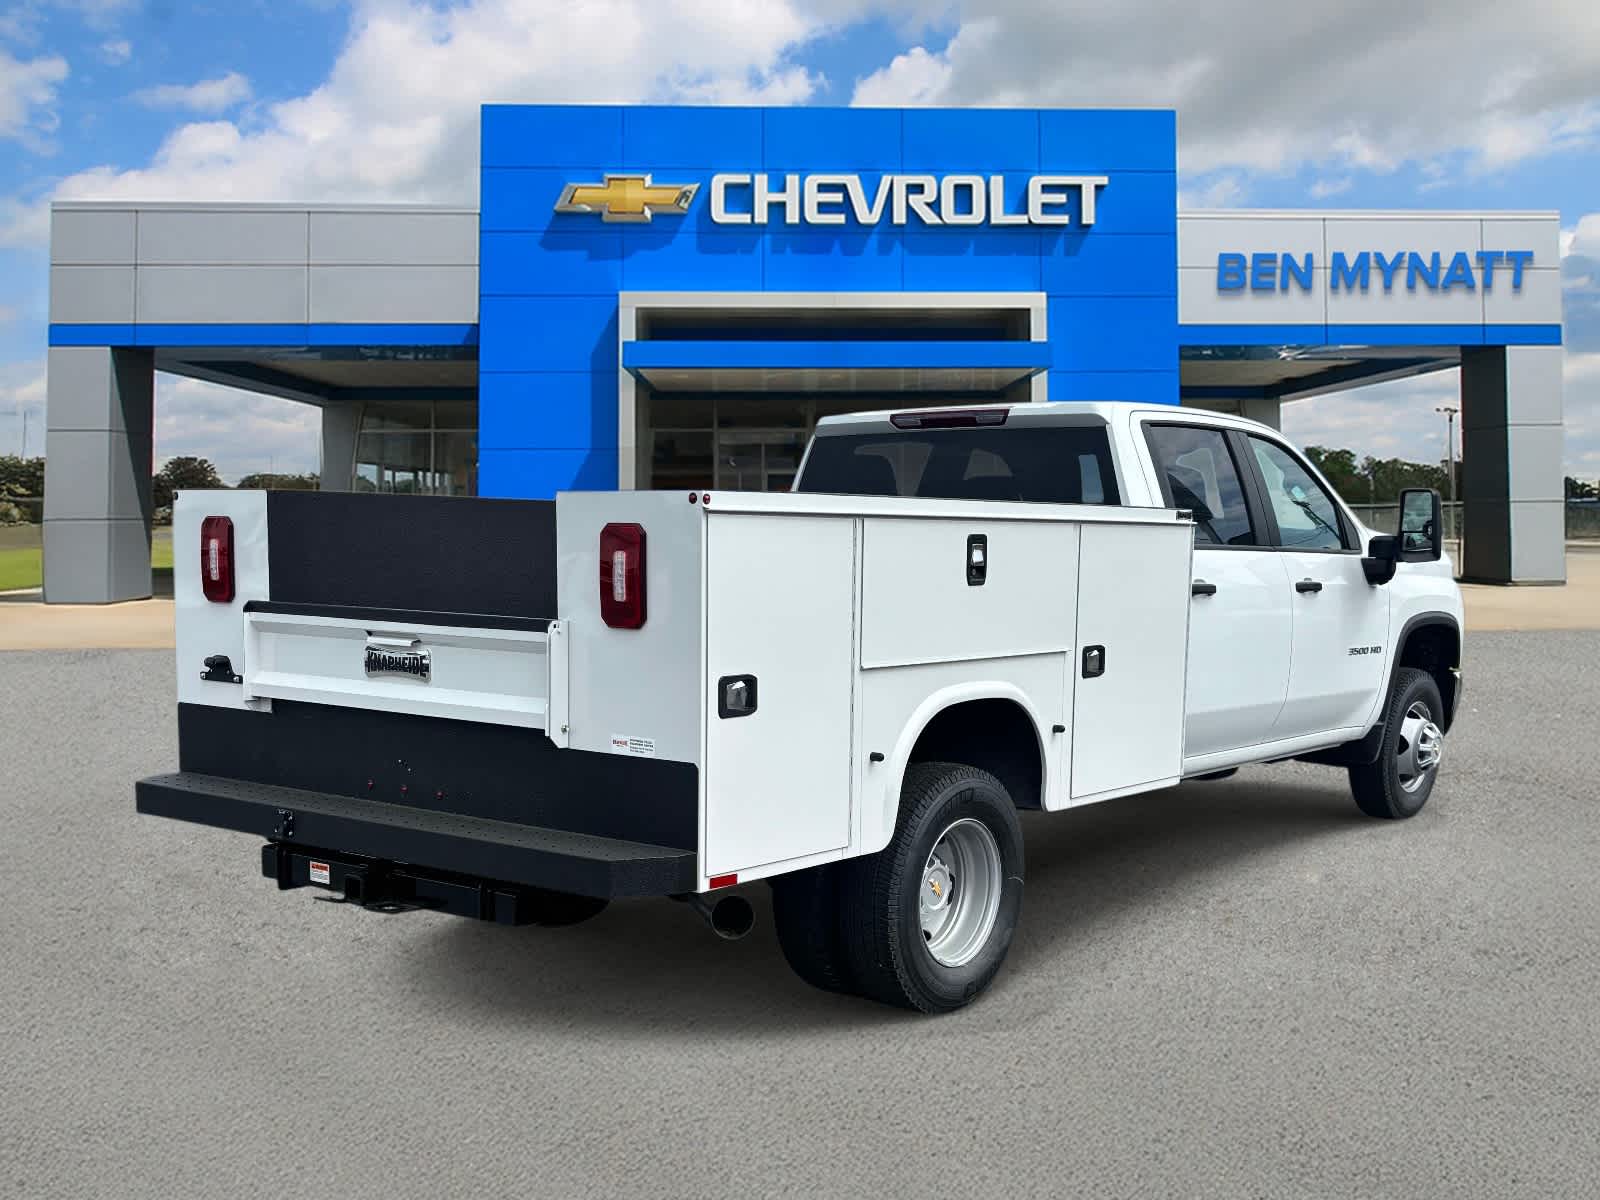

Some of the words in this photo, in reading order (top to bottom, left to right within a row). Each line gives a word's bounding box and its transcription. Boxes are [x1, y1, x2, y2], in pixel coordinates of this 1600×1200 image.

[709, 173, 1109, 225] CHEVROLET
[1216, 252, 1314, 291] BEN
[1329, 250, 1535, 291] MYNATT
[366, 649, 430, 678] KNAPHEIDE
[1347, 646, 1369, 656] 3500
[1370, 645, 1382, 654] HD
